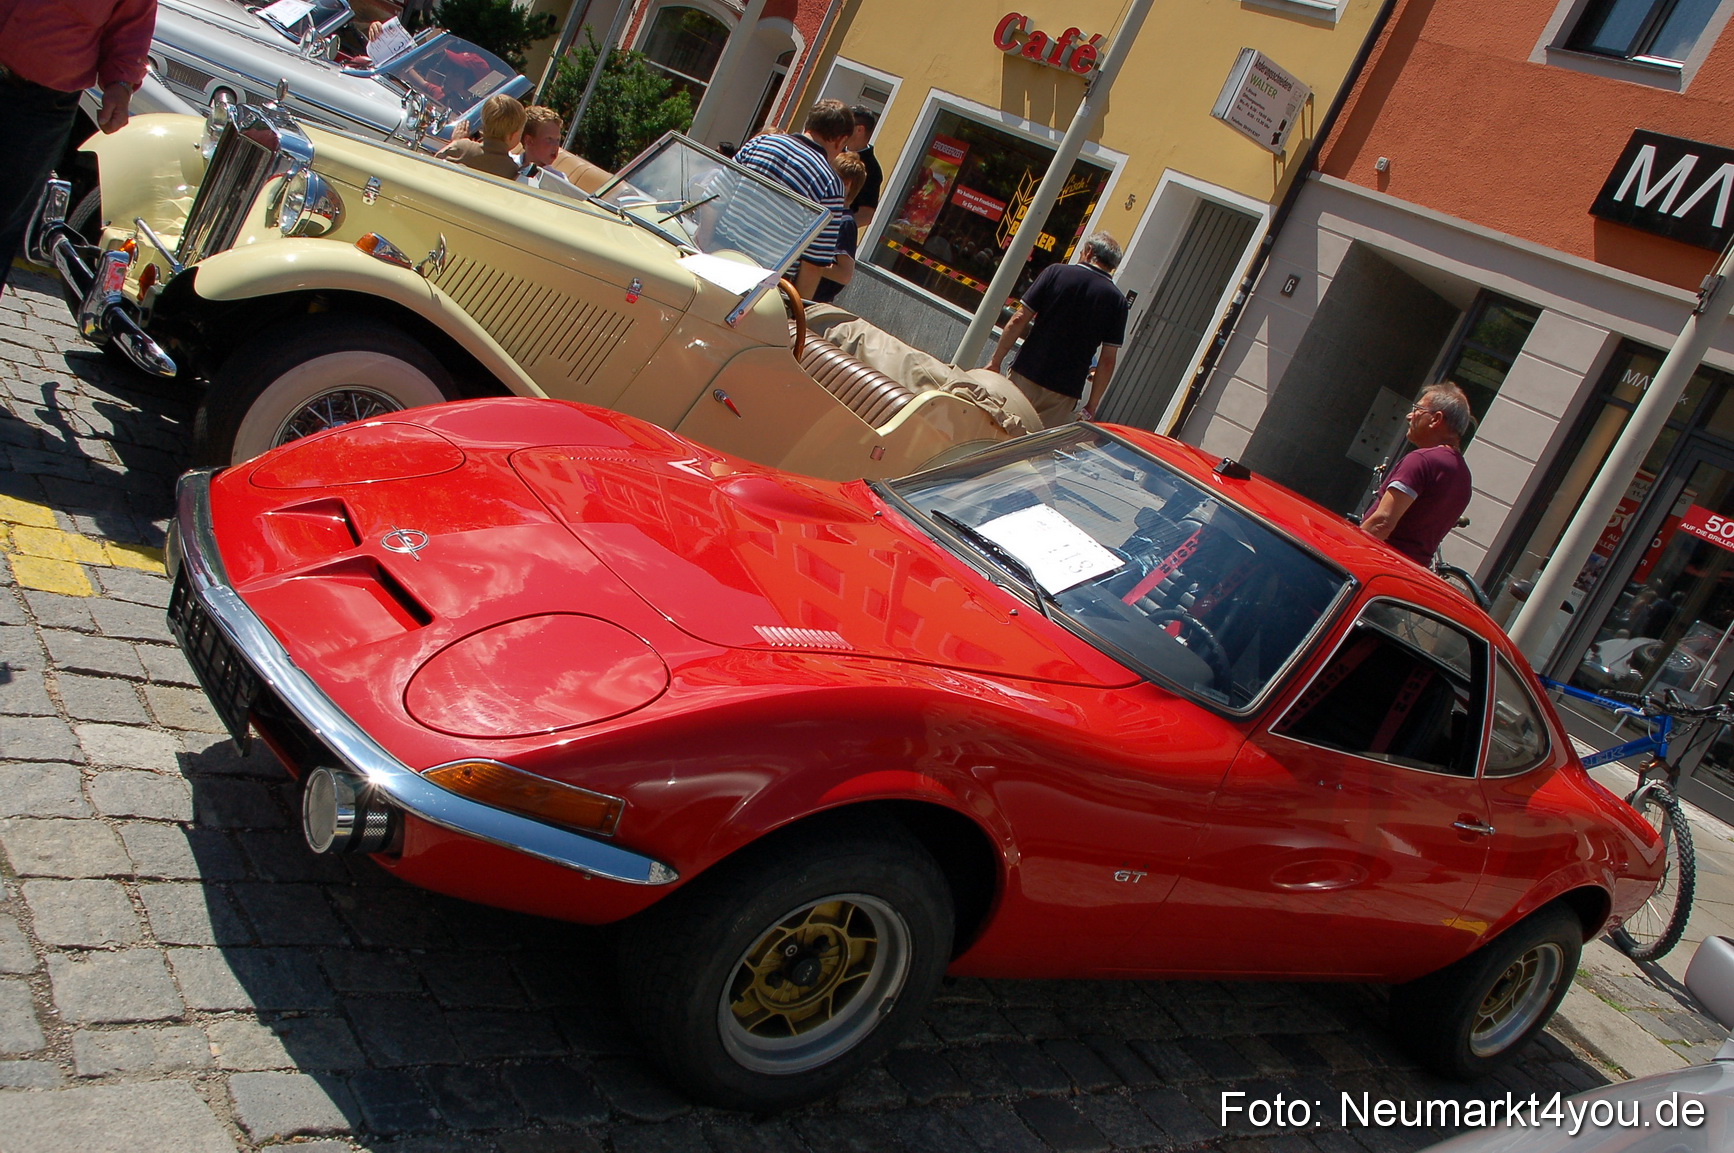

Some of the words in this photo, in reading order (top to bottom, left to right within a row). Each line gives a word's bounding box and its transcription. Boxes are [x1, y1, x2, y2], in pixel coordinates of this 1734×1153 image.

[993, 12, 1102, 75] Café
[1249, 74, 1278, 99] WALTER
[1124, 193, 1136, 211] 5
[1284, 278, 1295, 292] 6
[1681, 522, 1696, 531] AUF
[1695, 528, 1708, 537] DIE
[1113, 870, 1148, 884] GT
